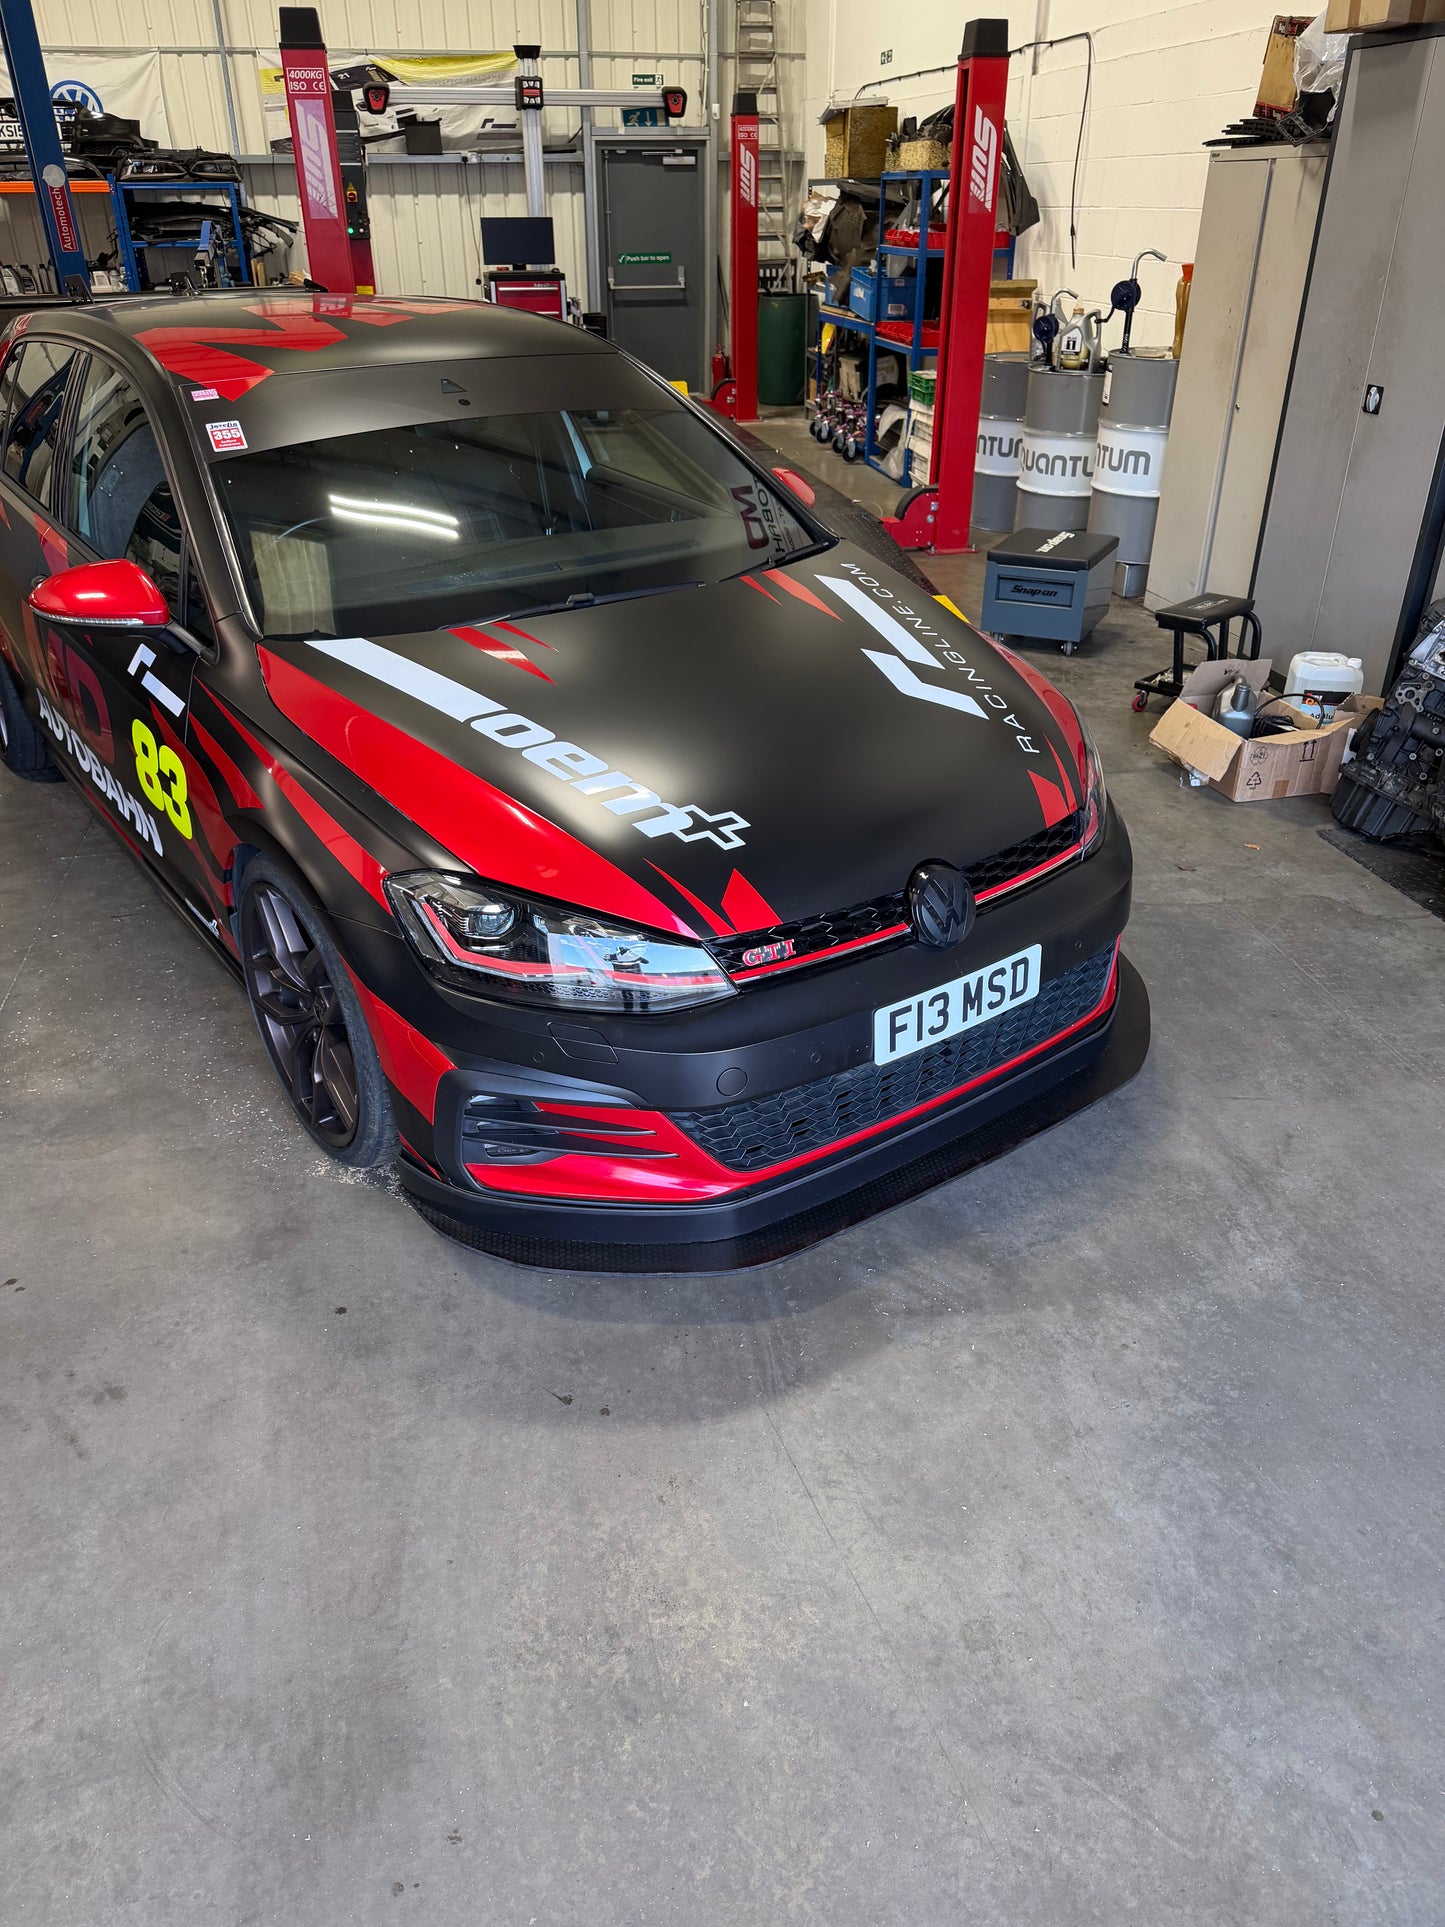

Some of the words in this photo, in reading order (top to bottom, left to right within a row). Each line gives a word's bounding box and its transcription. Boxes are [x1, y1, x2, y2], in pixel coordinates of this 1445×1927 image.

[289, 70, 323, 79] 4000KG
[290, 81, 307, 91] ISO
[52, 188, 73, 250] Automotech
[212, 429, 241, 440] 355
[1010, 584, 1058, 597] Snap-on
[840, 563, 1040, 754] RACINGLINE.COM
[36, 687, 163, 857] AUTOBAHN
[132, 718, 193, 840] 83
[742, 938, 797, 967] GTI
[889, 990, 950, 1054] F13
[962, 956, 1030, 1024] MSD
